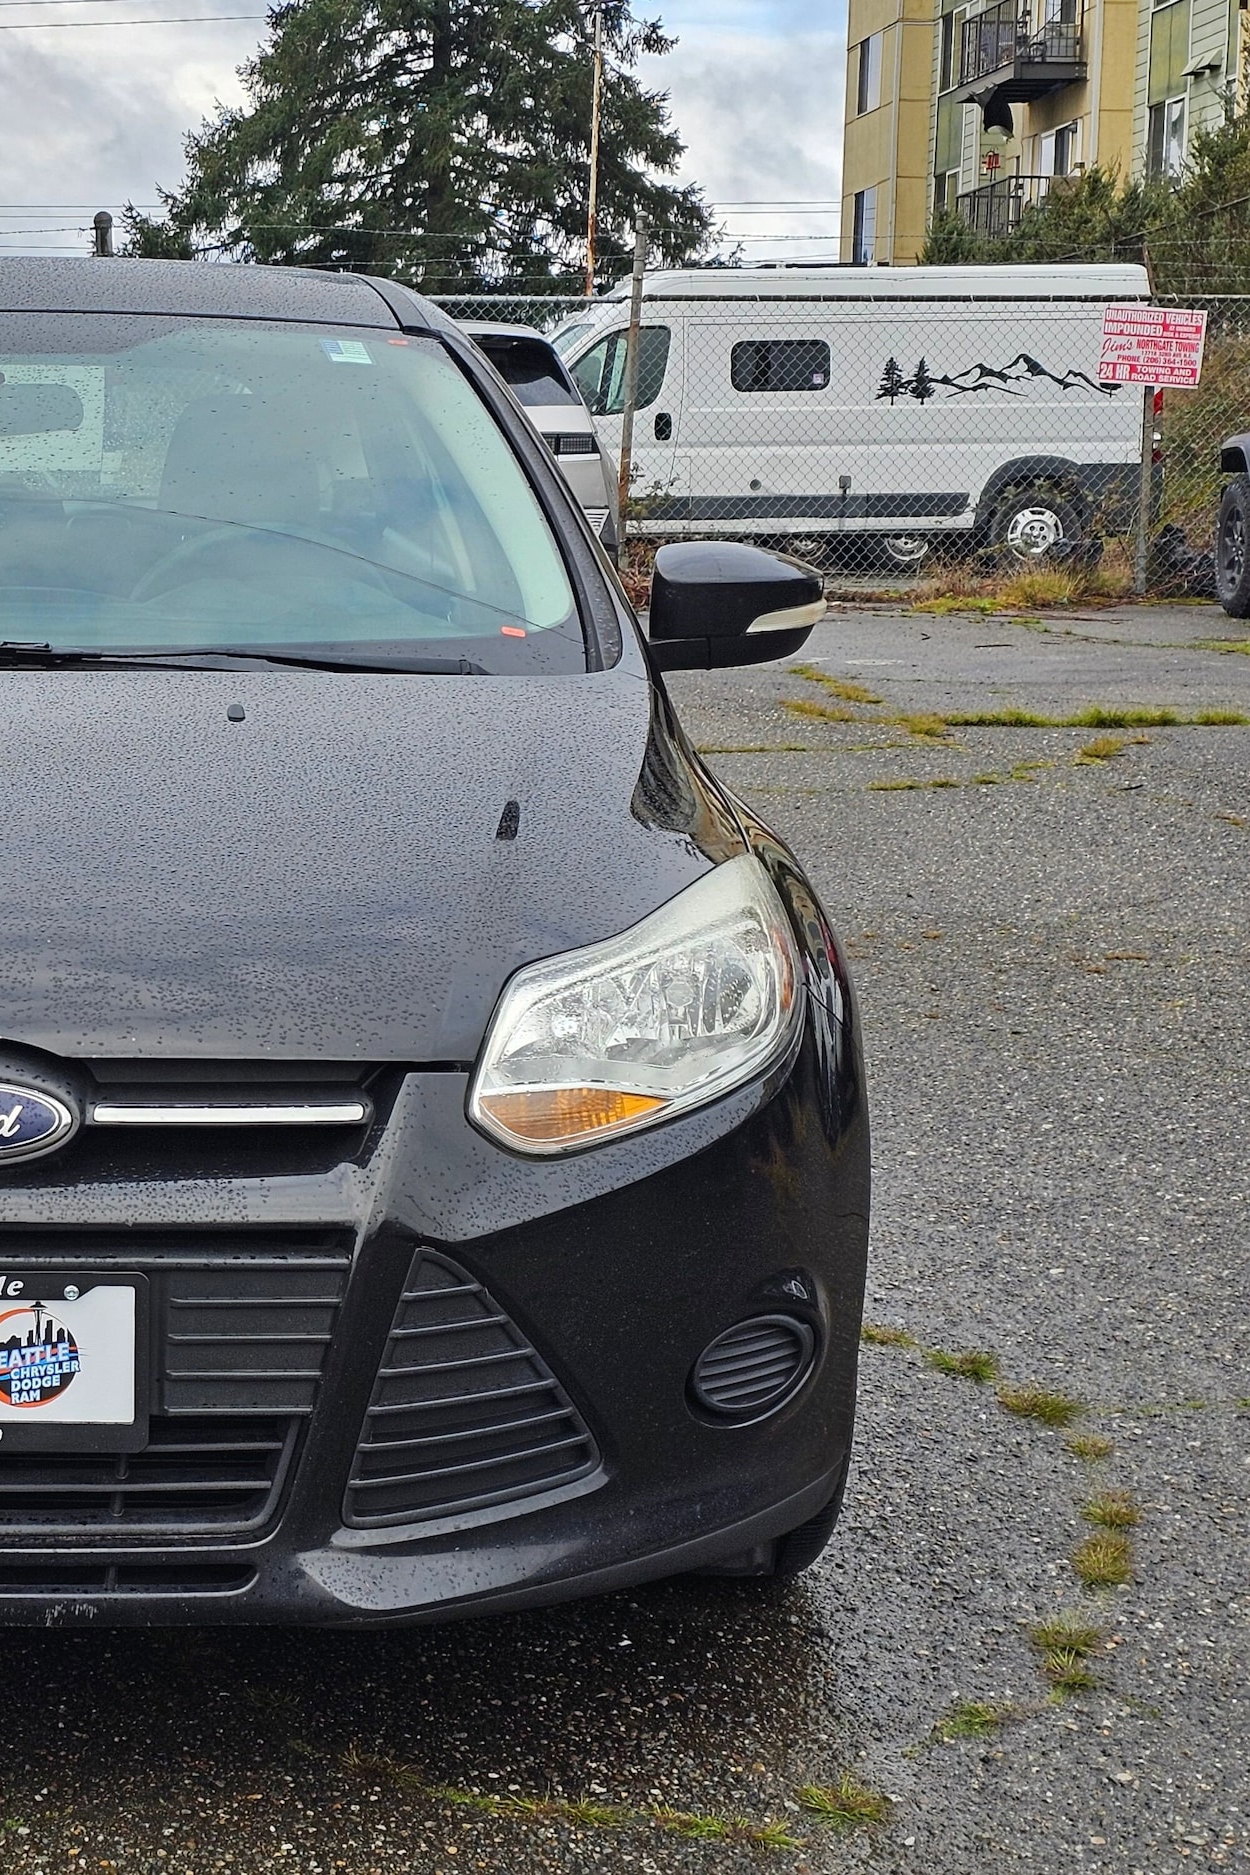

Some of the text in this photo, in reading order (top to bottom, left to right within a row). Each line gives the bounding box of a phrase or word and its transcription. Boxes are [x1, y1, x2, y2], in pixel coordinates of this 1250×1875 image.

[1106, 309, 1202, 326] UNAUTHORIZED VEHICLES
[1104, 322, 1163, 336] IMPOUNDED
[1101, 338, 1199, 358] Jim's NORTHGATE TOWING
[1117, 354, 1141, 363] PHONE
[1099, 363, 1130, 380] 24 HR
[1131, 373, 1195, 384] ROAD SERVICE
[1136, 366, 1192, 376] TOWING AND
[10, 1359, 80, 1379] CHRYSLER
[10, 1375, 61, 1392] DODGE
[10, 1390, 41, 1405] RAM
